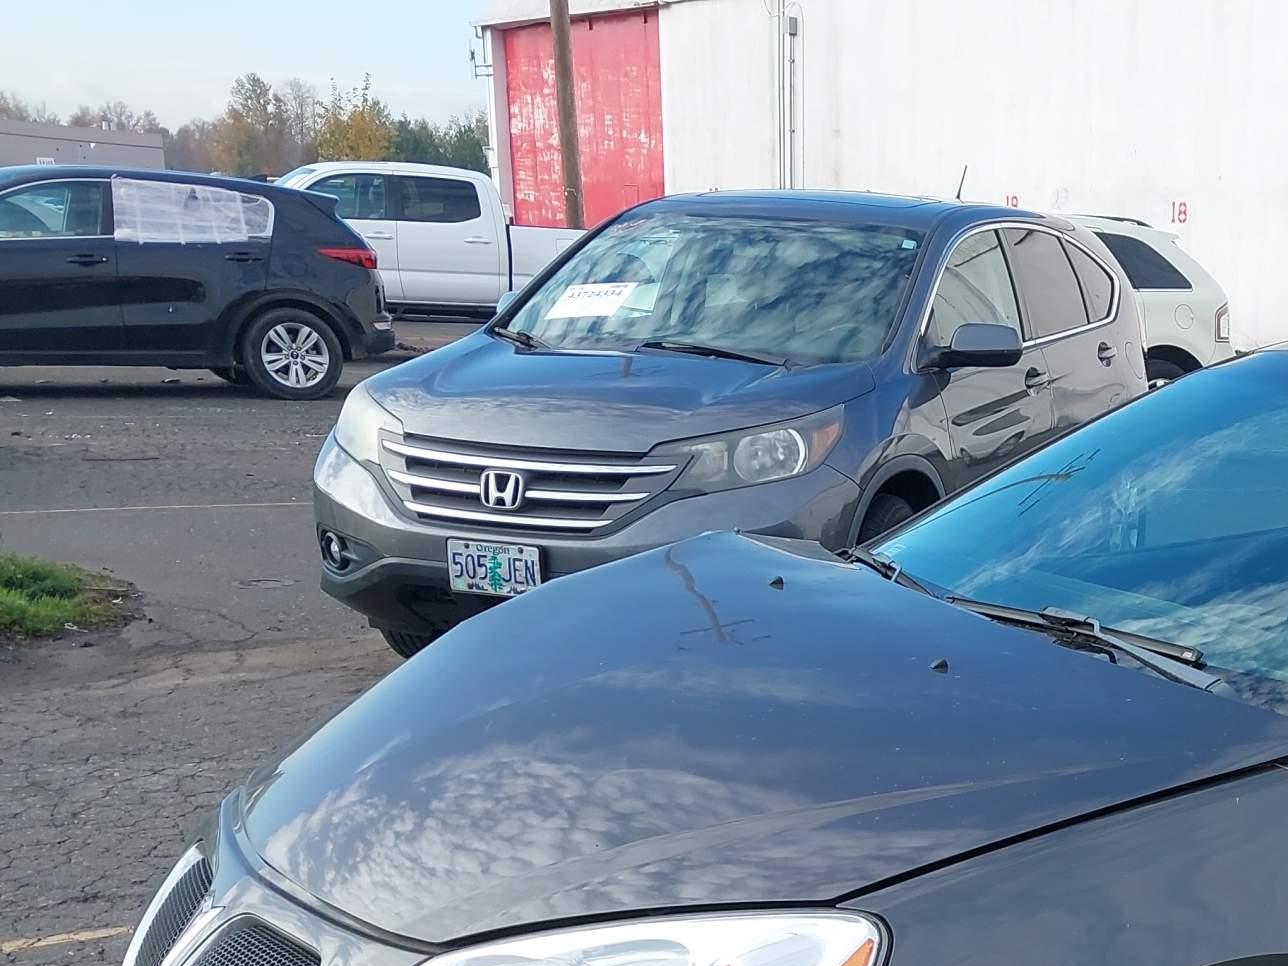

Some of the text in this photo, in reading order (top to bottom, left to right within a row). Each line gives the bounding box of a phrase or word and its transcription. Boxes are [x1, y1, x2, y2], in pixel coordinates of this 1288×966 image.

[1171, 201, 1188, 223] 18
[476, 544, 511, 555] Oregon
[452, 552, 537, 586] 505 JEN
